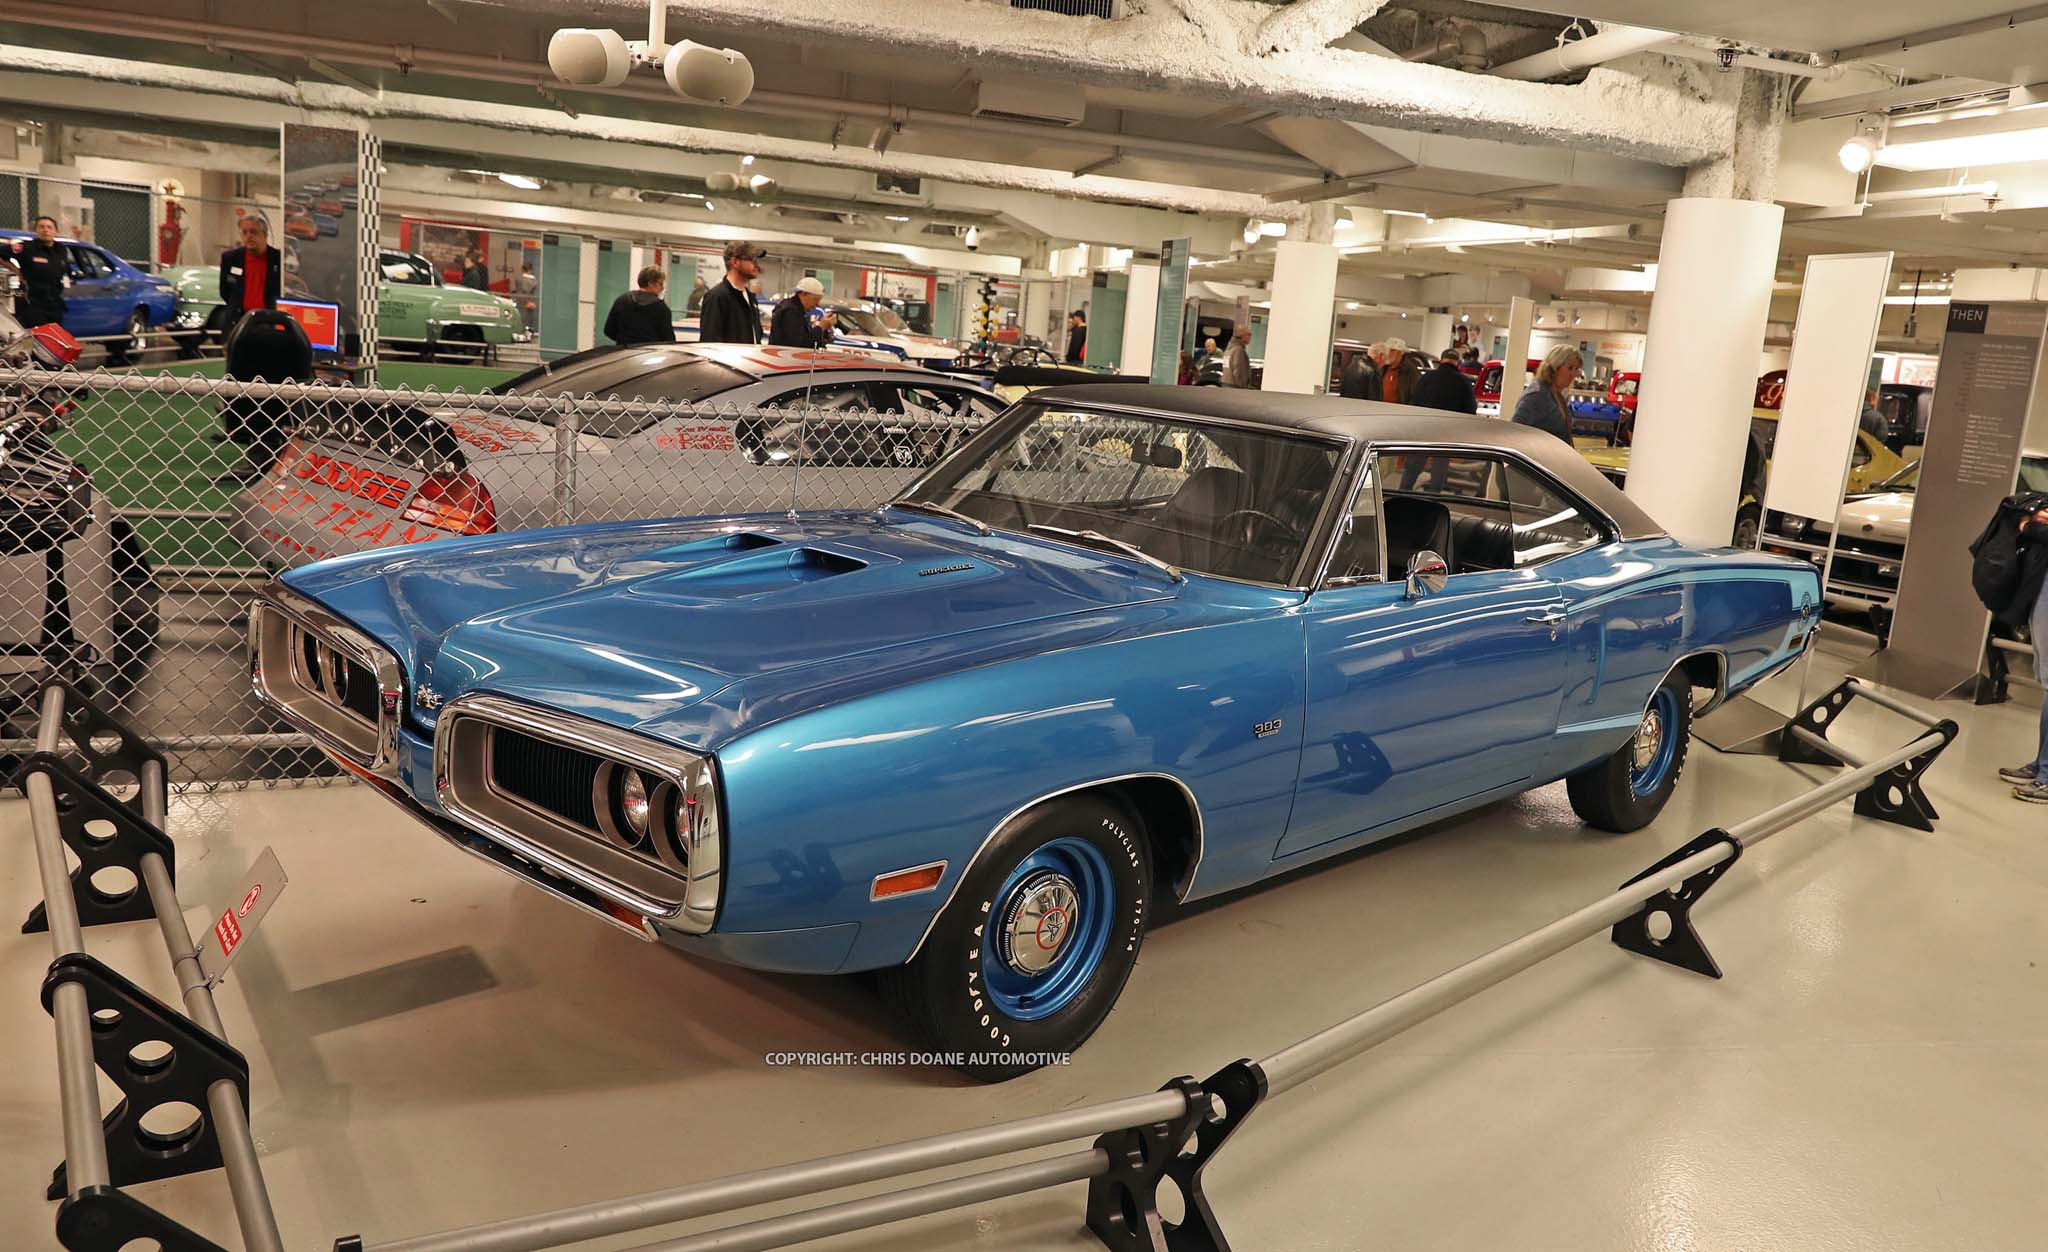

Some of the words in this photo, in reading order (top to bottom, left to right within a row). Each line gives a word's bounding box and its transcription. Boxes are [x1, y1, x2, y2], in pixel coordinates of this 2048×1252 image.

[1951, 309, 1984, 321] THEN
[294, 452, 411, 509] DODGE
[1255, 719, 1282, 734] 383
[1102, 818, 1139, 868] POLYGLAS
[968, 900, 1010, 1047] GOODYEAR
